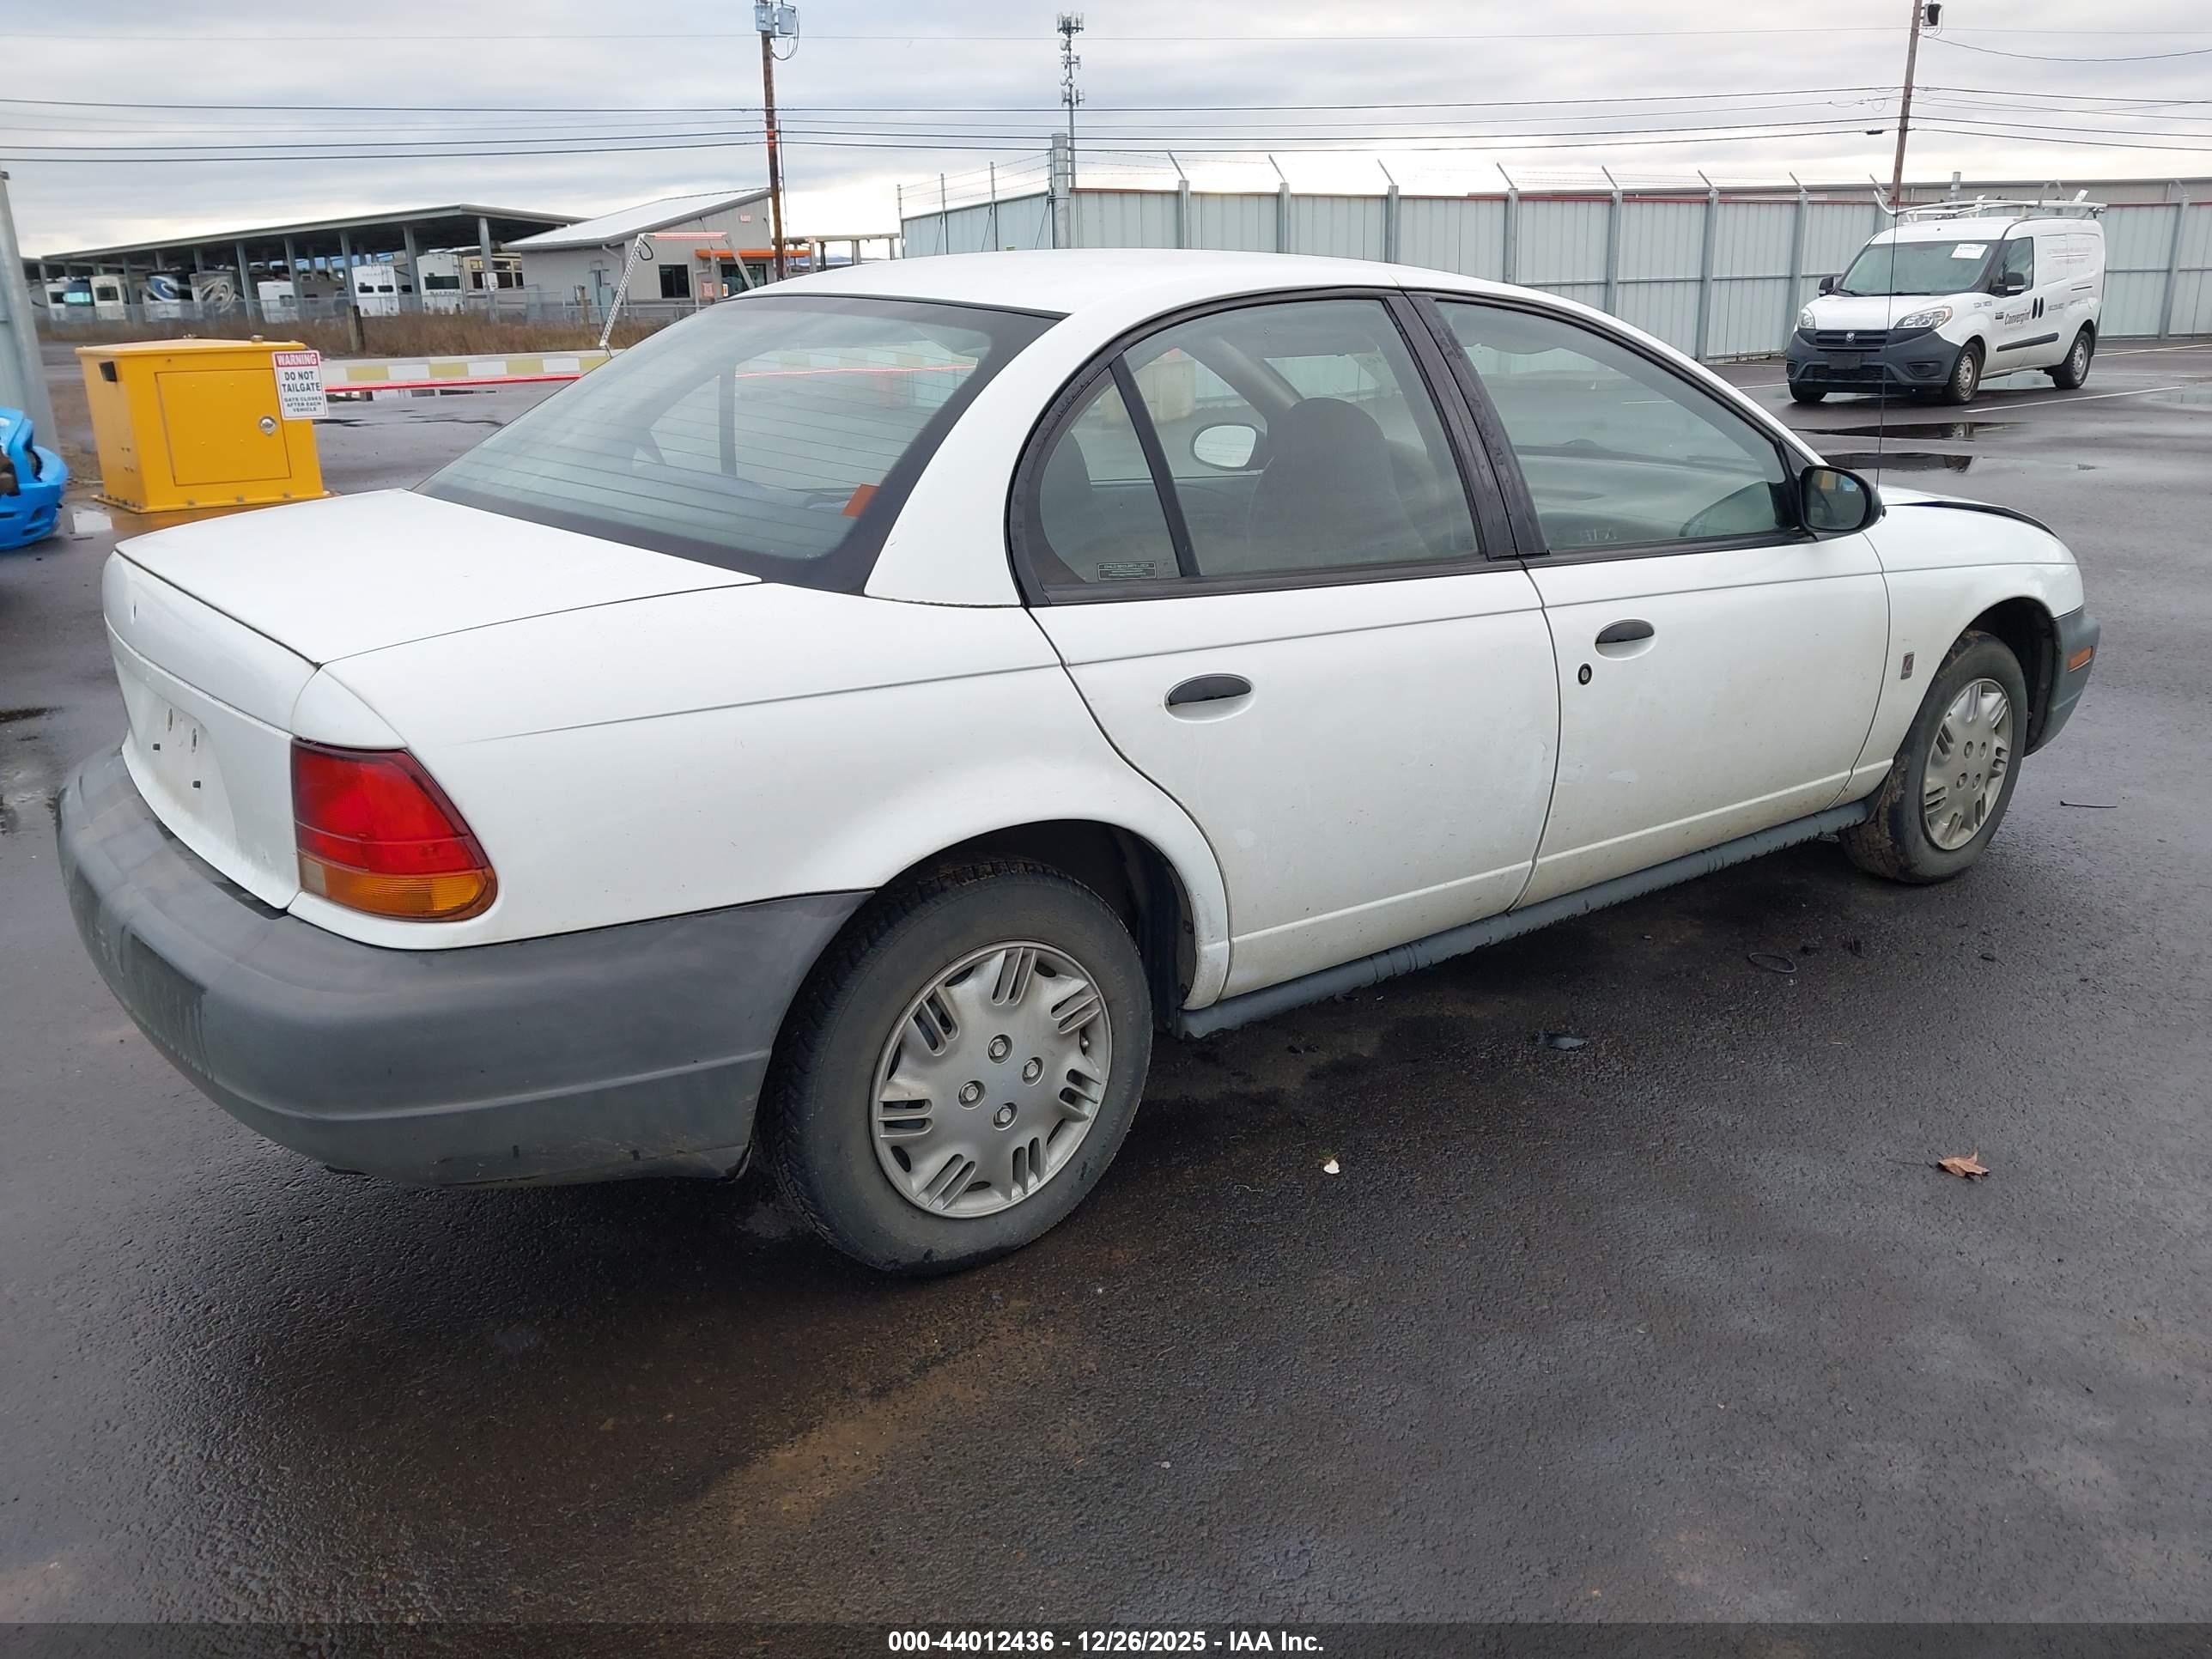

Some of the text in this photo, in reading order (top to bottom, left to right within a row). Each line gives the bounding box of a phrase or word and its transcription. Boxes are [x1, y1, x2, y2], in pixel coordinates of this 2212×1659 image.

[276, 353, 318, 366] WARNING
[284, 371, 314, 380] DO NOT
[282, 382, 321, 392] TAILGATE
